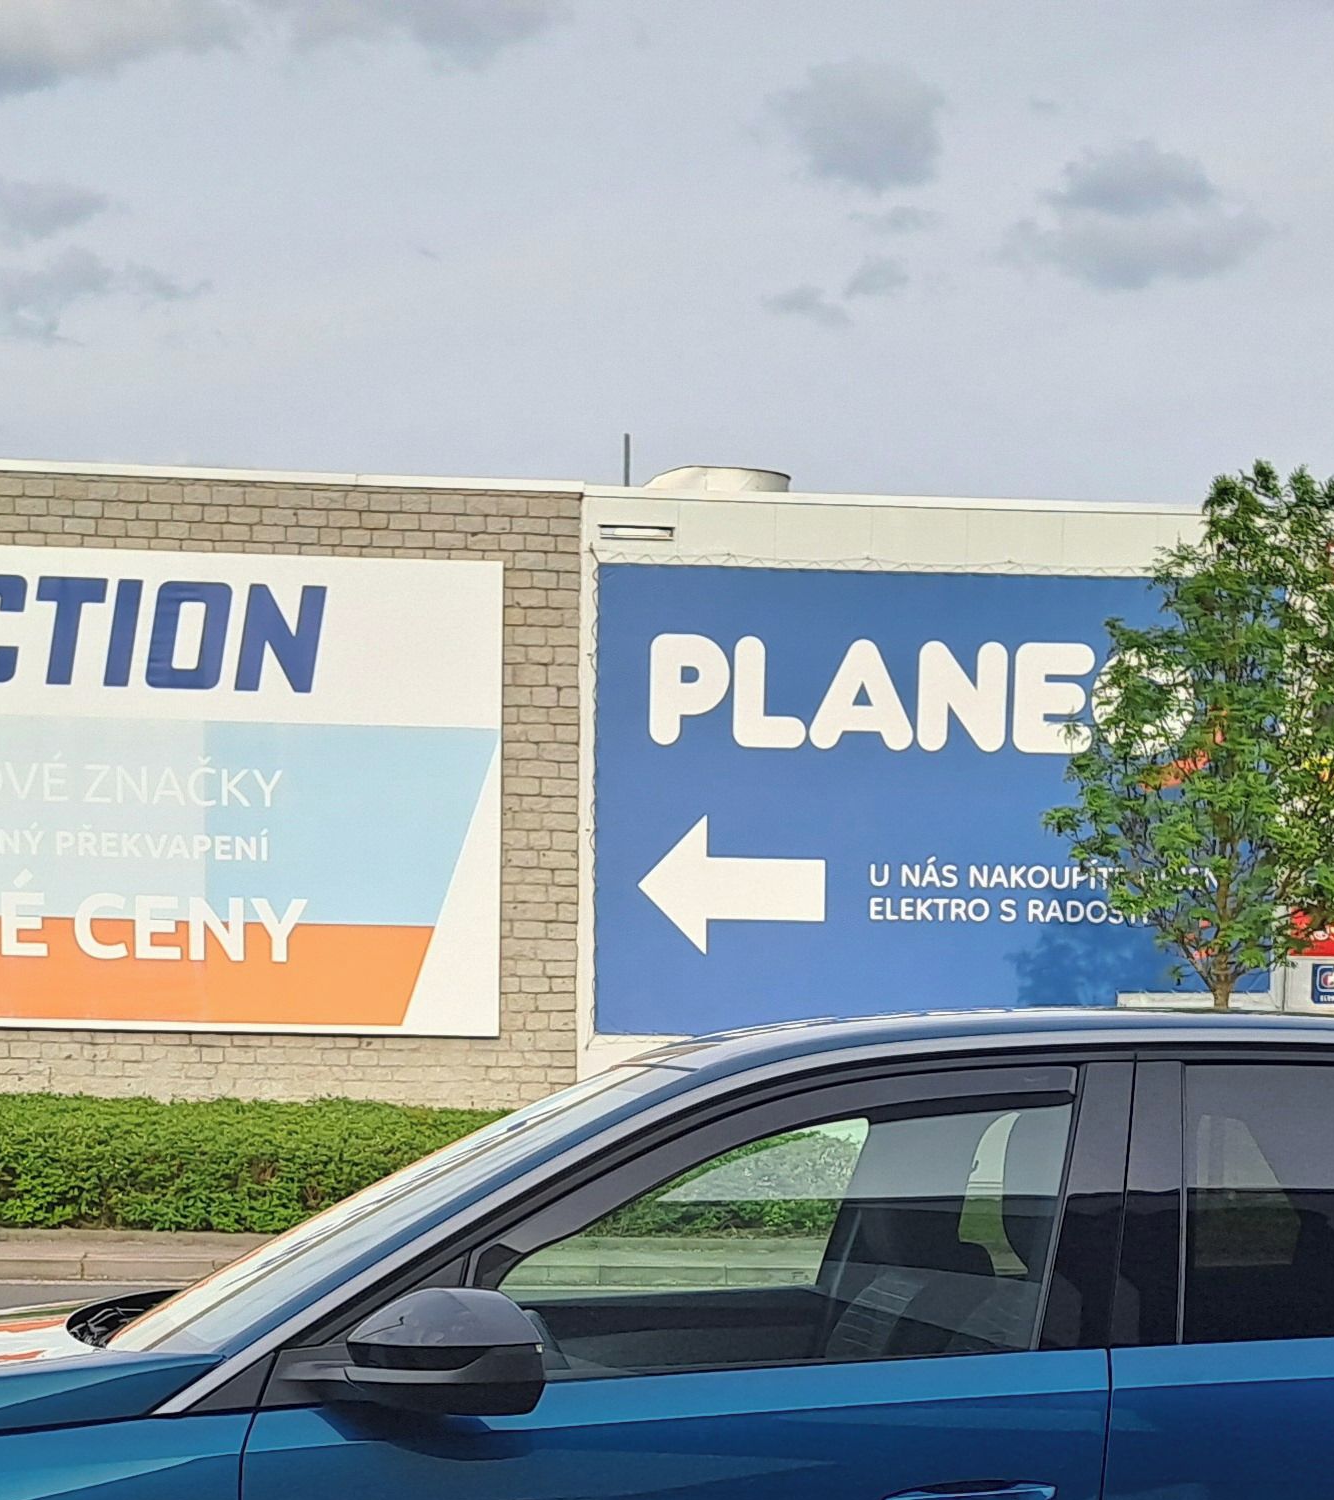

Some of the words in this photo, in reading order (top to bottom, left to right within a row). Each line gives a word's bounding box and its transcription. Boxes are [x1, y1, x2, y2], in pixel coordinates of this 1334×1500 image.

[82, 755, 284, 808] ZNAČKY
[55, 823, 269, 862] PŘEKVAPENÍ
[870, 863, 890, 887] U
[901, 856, 958, 888] NÁS
[969, 859, 1126, 890] NAKOUPÍT
[74, 892, 308, 963] CENY
[869, 897, 990, 922] ELEKTRO
[1000, 899, 1017, 922] S
